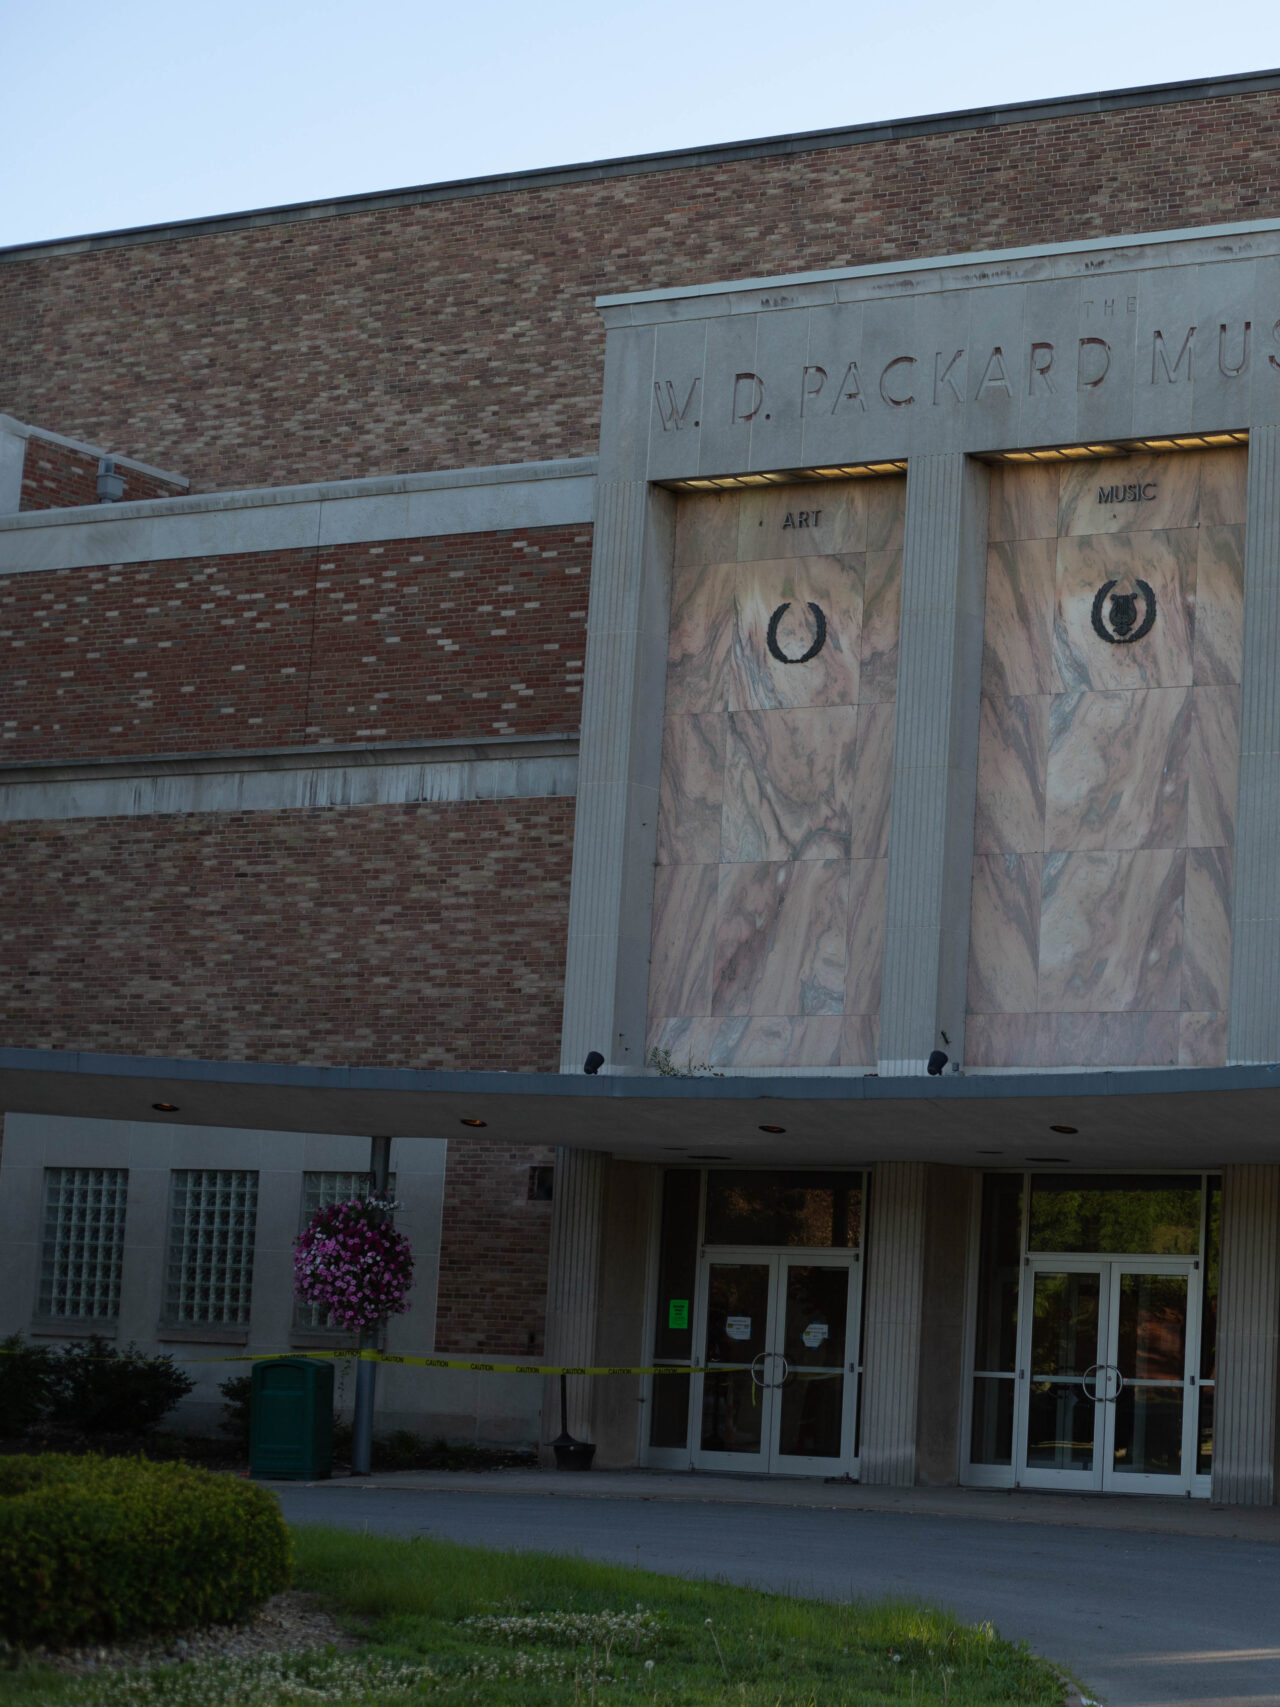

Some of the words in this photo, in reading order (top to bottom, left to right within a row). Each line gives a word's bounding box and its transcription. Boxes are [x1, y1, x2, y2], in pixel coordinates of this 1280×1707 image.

[1083, 296, 1137, 319] THE
[654, 377, 701, 432] W.
[731, 372, 772, 425] D.
[800, 336, 1112, 419] PACKARD
[1098, 482, 1157, 505] MUSIC
[782, 509, 821, 530] ART
[381, 1355, 405, 1363] CAUTION
[425, 1359, 449, 1367] CAUTION
[470, 1363, 494, 1371] CAUTION
[515, 1366, 540, 1374] CAUTION
[561, 1367, 586, 1375] CAUTION
[608, 1368, 632, 1376] CAUTION
[654, 1368, 678, 1376] CAUTION
